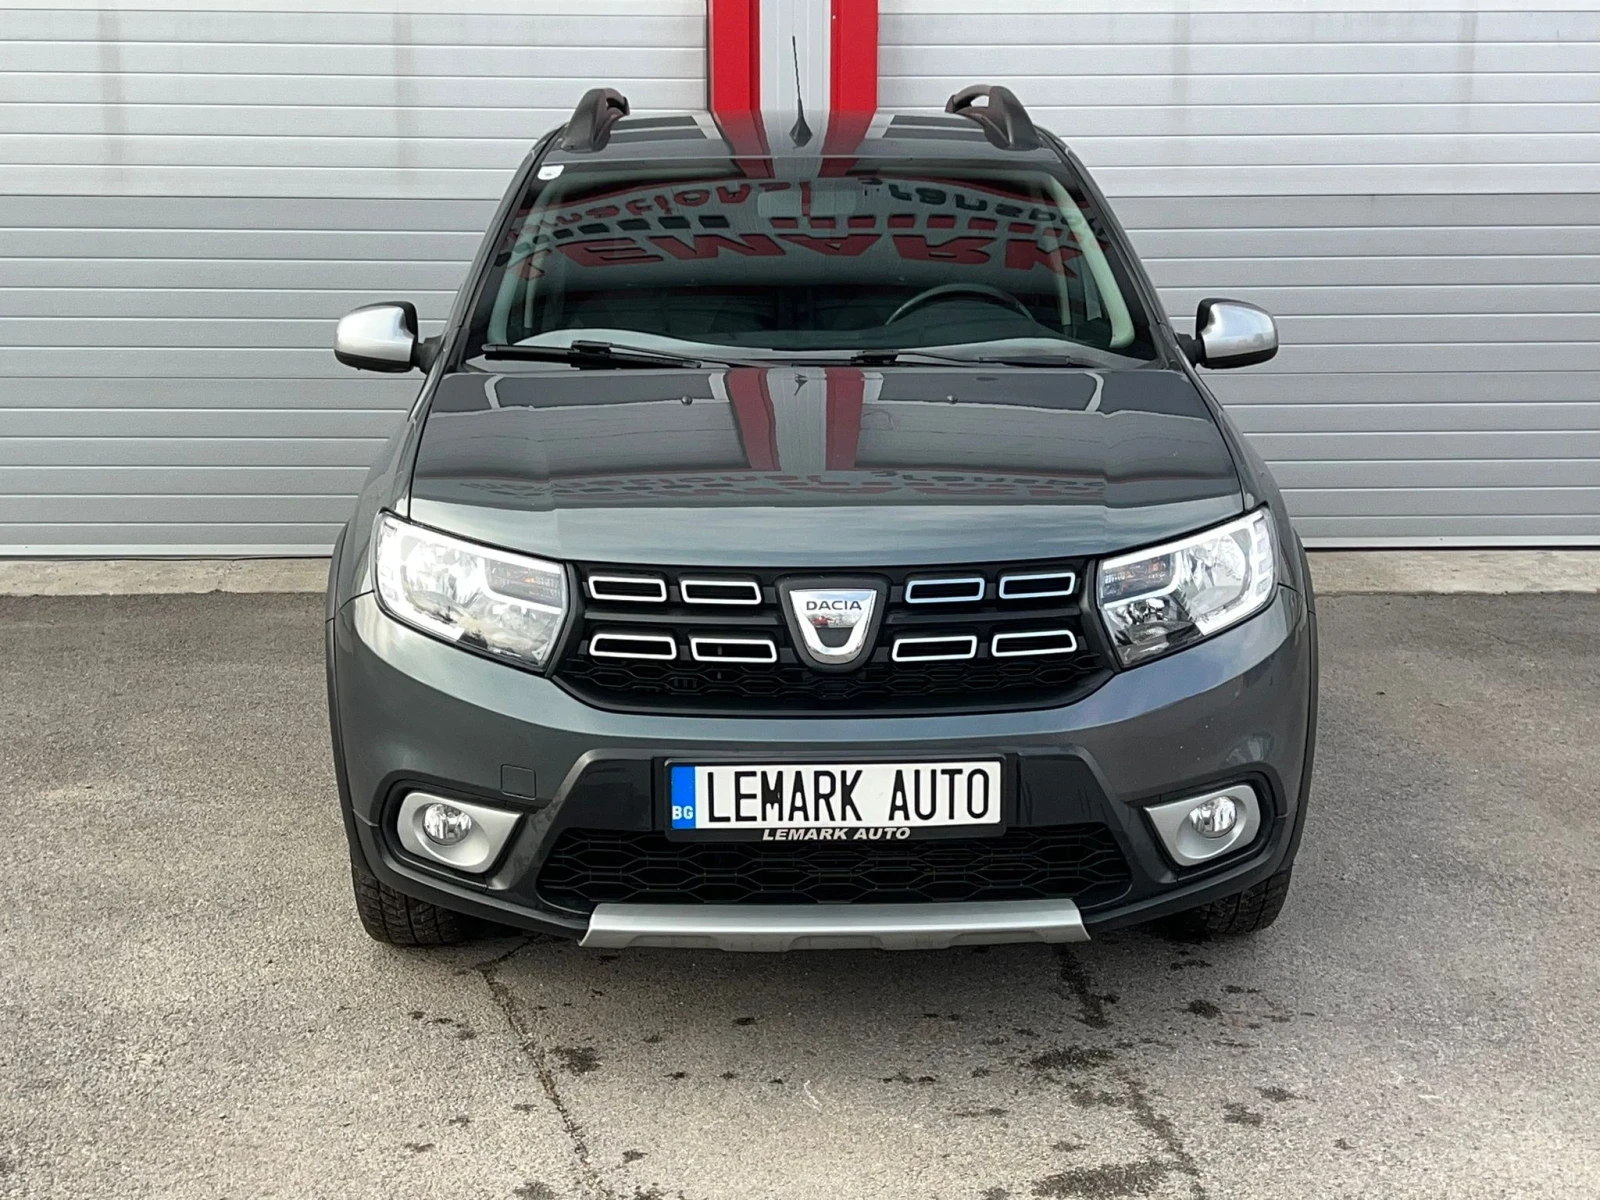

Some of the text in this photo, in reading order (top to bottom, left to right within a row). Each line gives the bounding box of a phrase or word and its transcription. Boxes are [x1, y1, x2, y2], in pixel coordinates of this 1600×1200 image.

[806, 600, 862, 611] DACIA
[707, 768, 990, 822] LEMARK AUTO
[672, 805, 694, 820] BG
[762, 826, 910, 841] LEMARK AUTO
